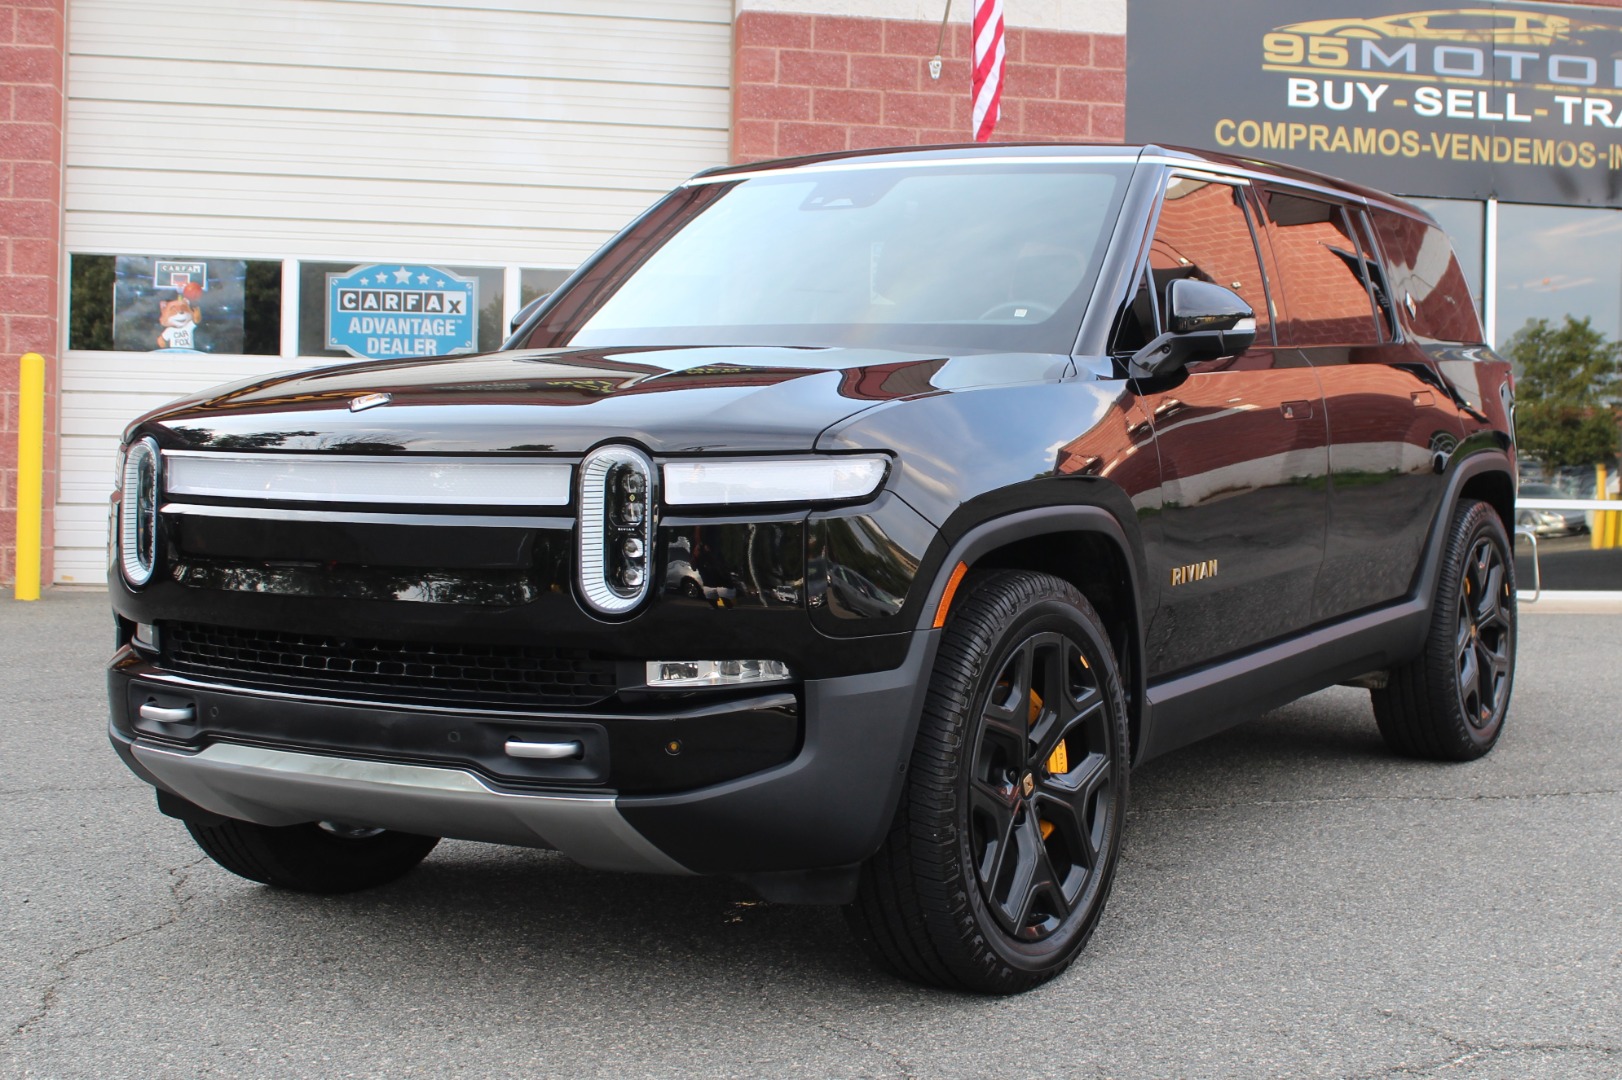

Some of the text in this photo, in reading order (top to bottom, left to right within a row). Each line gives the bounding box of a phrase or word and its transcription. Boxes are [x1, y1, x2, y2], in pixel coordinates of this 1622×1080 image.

[1262, 33, 1622, 88] 95 MOTO
[342, 292, 462, 314] CARFAX
[367, 337, 437, 356] DEALER
[1171, 559, 1218, 586] RIVIAN
